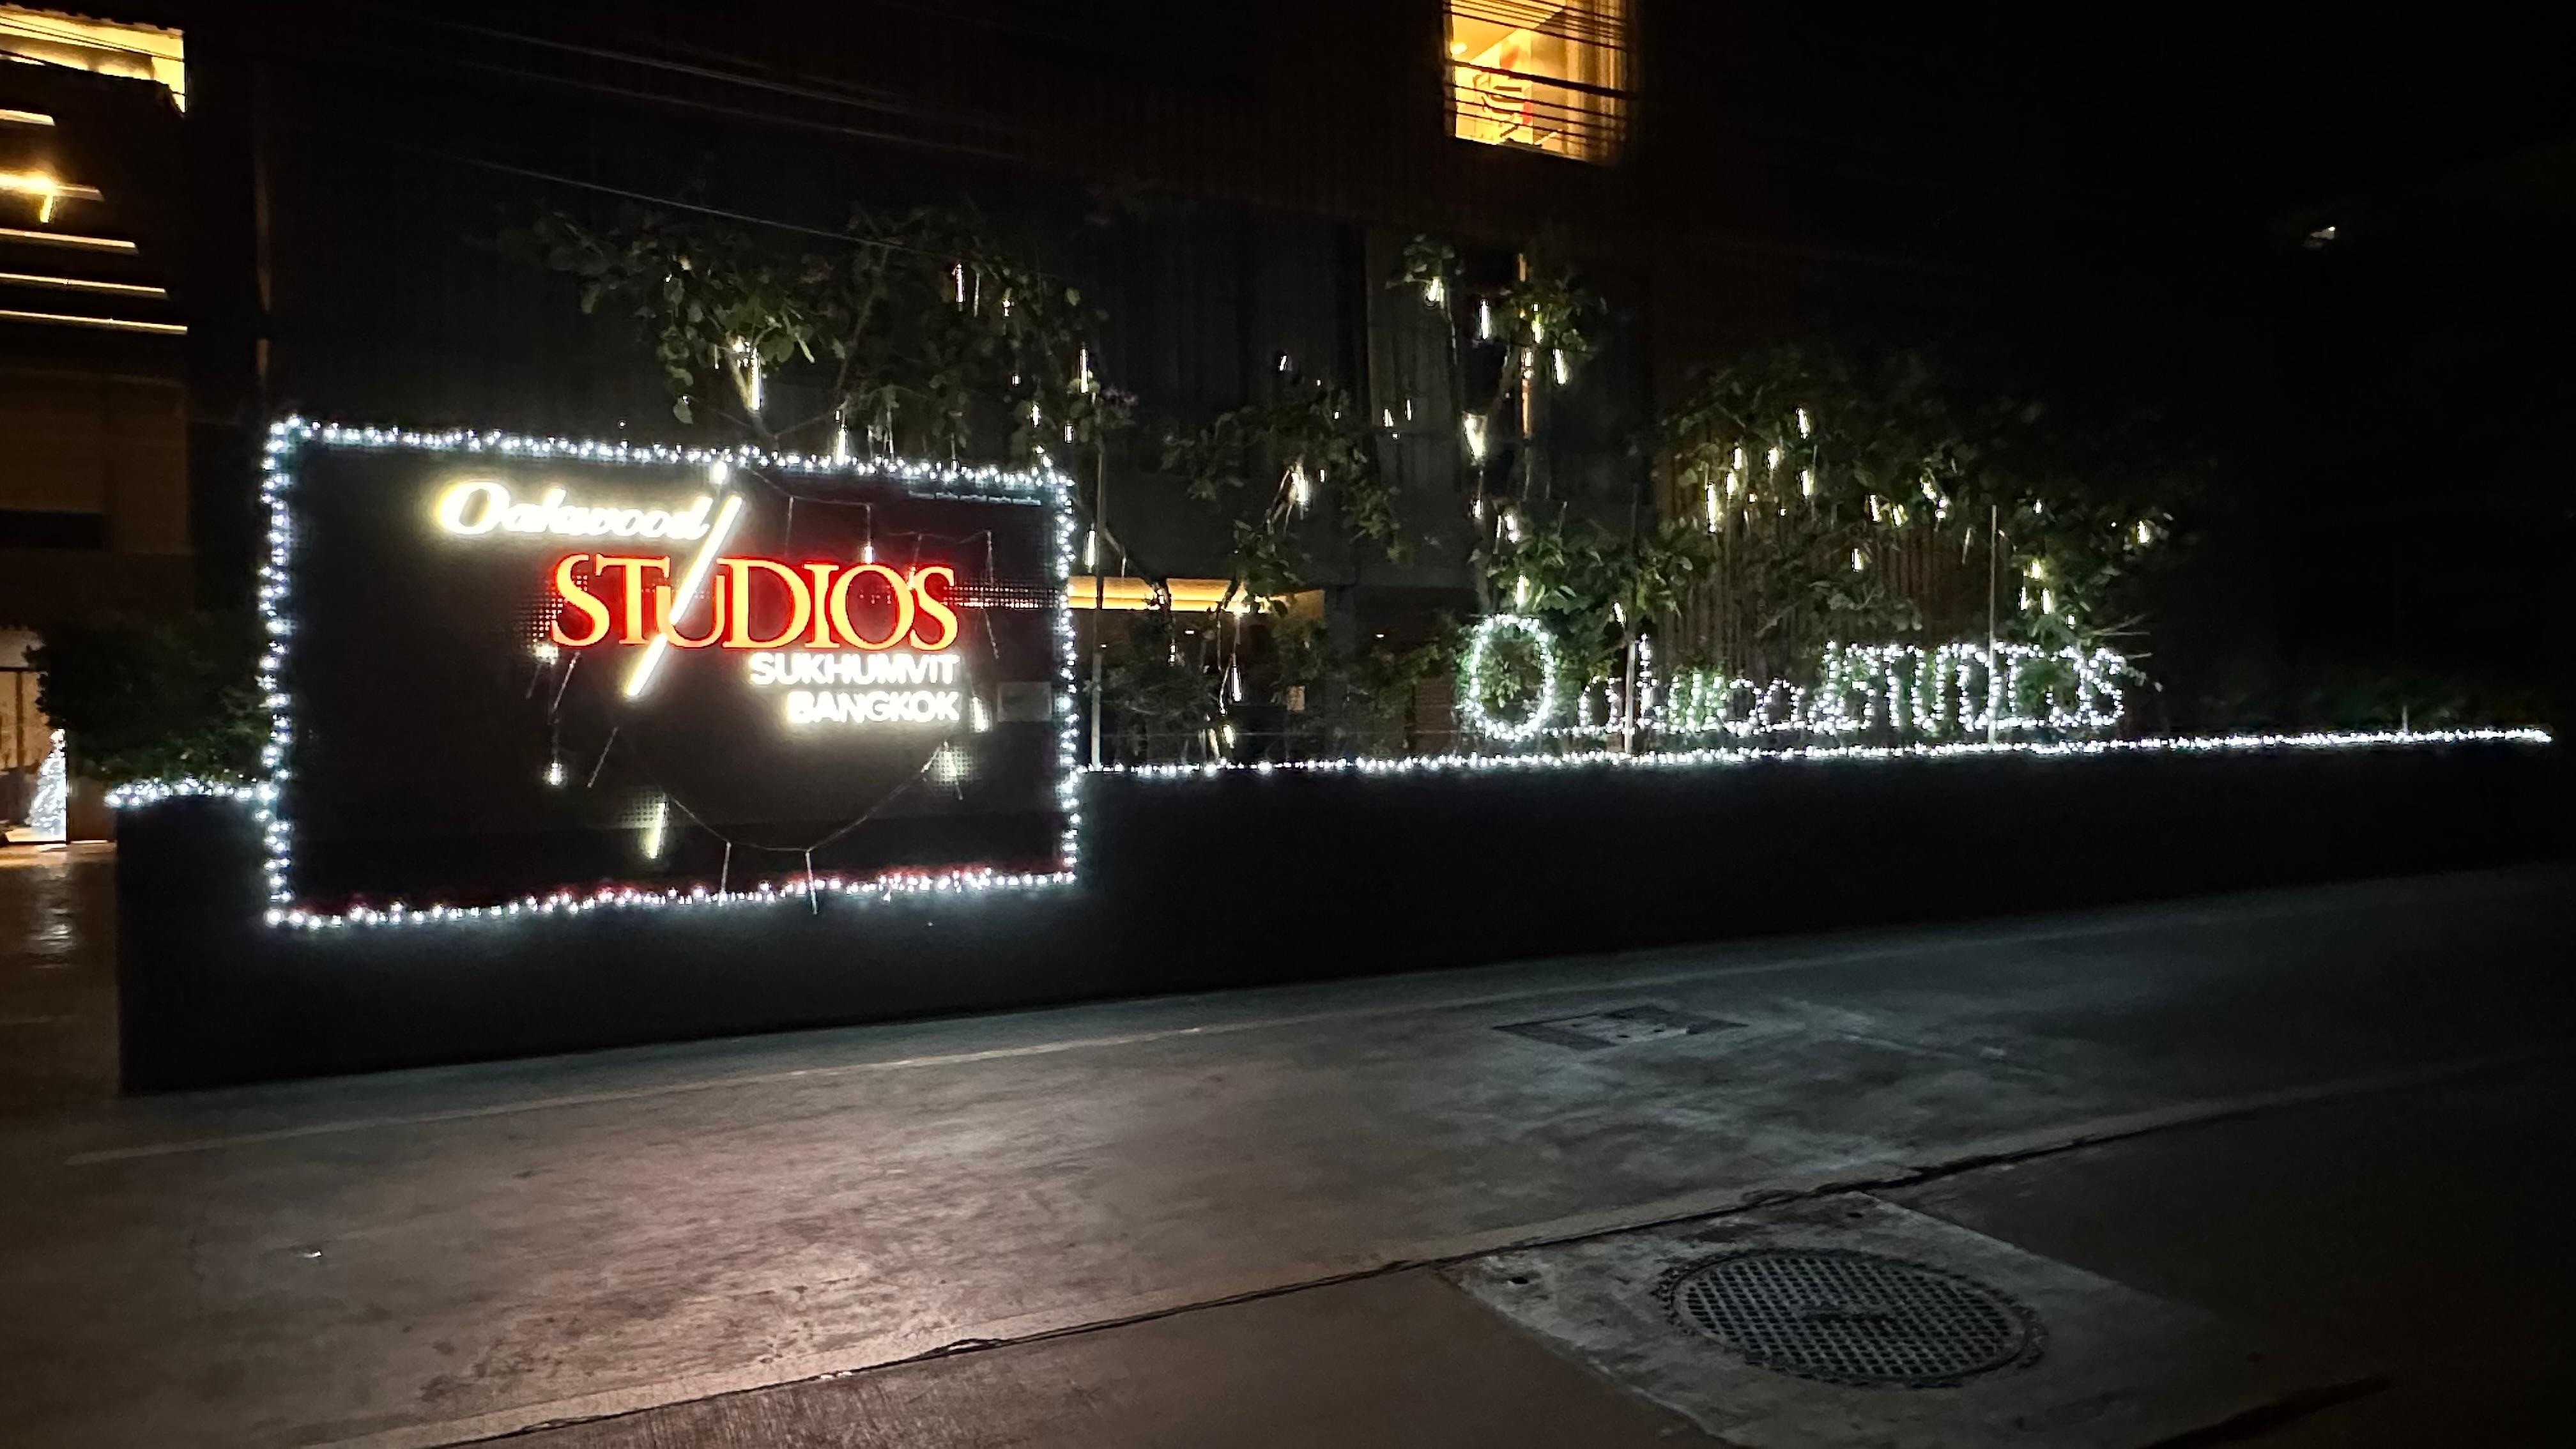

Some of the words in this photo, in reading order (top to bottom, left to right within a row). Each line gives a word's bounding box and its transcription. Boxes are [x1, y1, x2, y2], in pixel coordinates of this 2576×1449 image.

[438, 481, 714, 540] Oakwood
[551, 553, 959, 650] STUDIOS
[749, 653, 960, 686] SUKHUMVIT
[786, 691, 960, 723] BANGKOK
